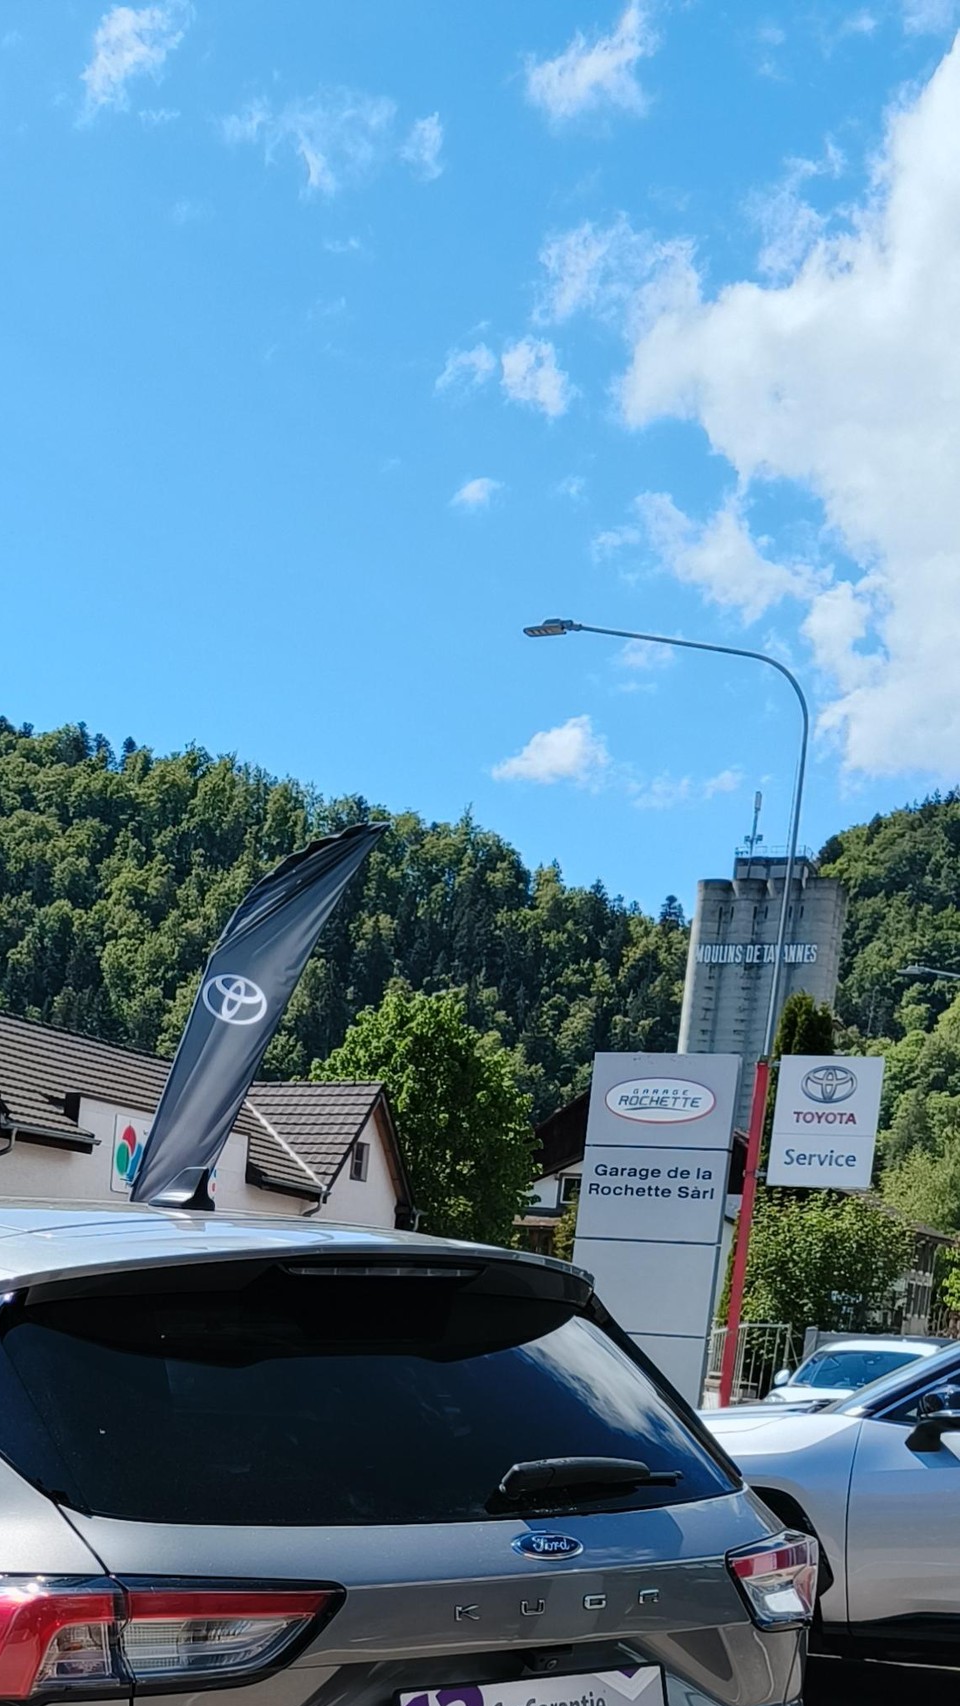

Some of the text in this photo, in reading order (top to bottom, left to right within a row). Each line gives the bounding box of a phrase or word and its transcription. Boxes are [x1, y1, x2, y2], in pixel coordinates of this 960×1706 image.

[695, 944, 742, 963] MOULINS
[745, 944, 760, 963] DE
[618, 1095, 702, 1108] ROCHETTE
[793, 1111, 857, 1125] TOYOTA
[784, 1148, 857, 1167] Service
[594, 1163, 712, 1180] Garage de la
[588, 1183, 672, 1198] Rochette
[532, 1535, 571, 1552] Ford
[455, 1588, 660, 1621] KUGA
